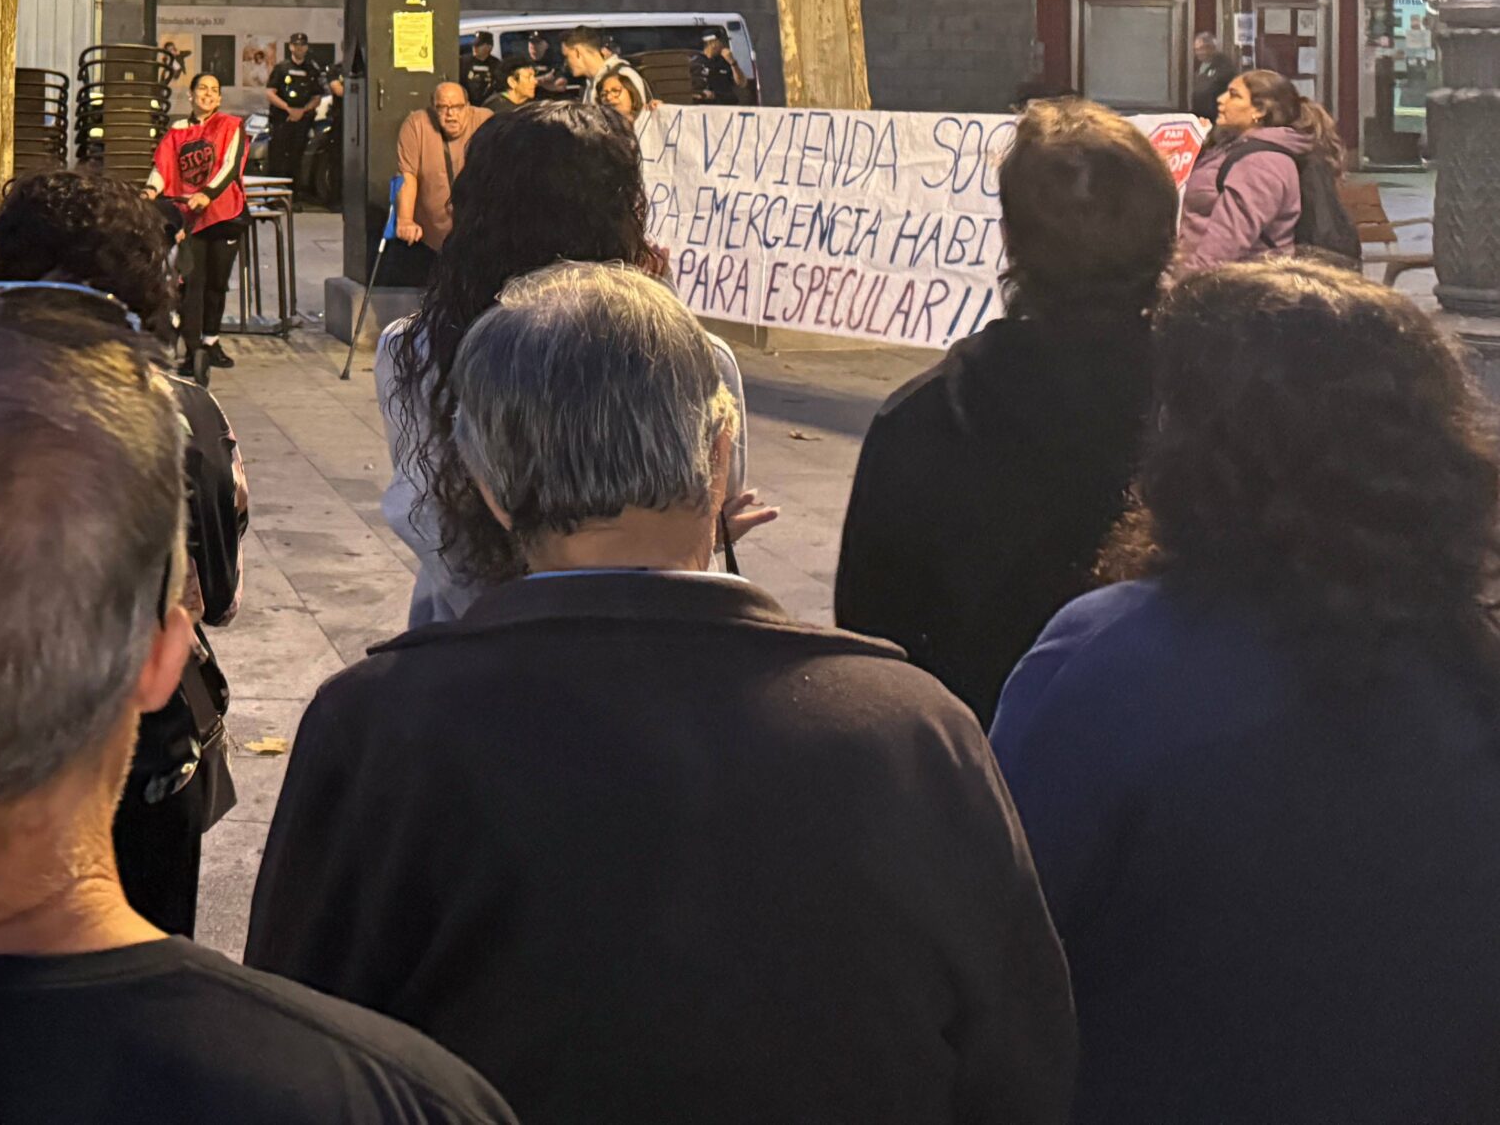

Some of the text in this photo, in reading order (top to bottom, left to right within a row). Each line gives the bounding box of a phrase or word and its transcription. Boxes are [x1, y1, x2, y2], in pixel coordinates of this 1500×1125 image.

[180, 146, 212, 171] STOP
[702, 112, 898, 191] VIVIENDA
[921, 117, 1013, 197] SOC
[687, 187, 882, 260] EMERGENCIA
[676, 248, 749, 317] PARA
